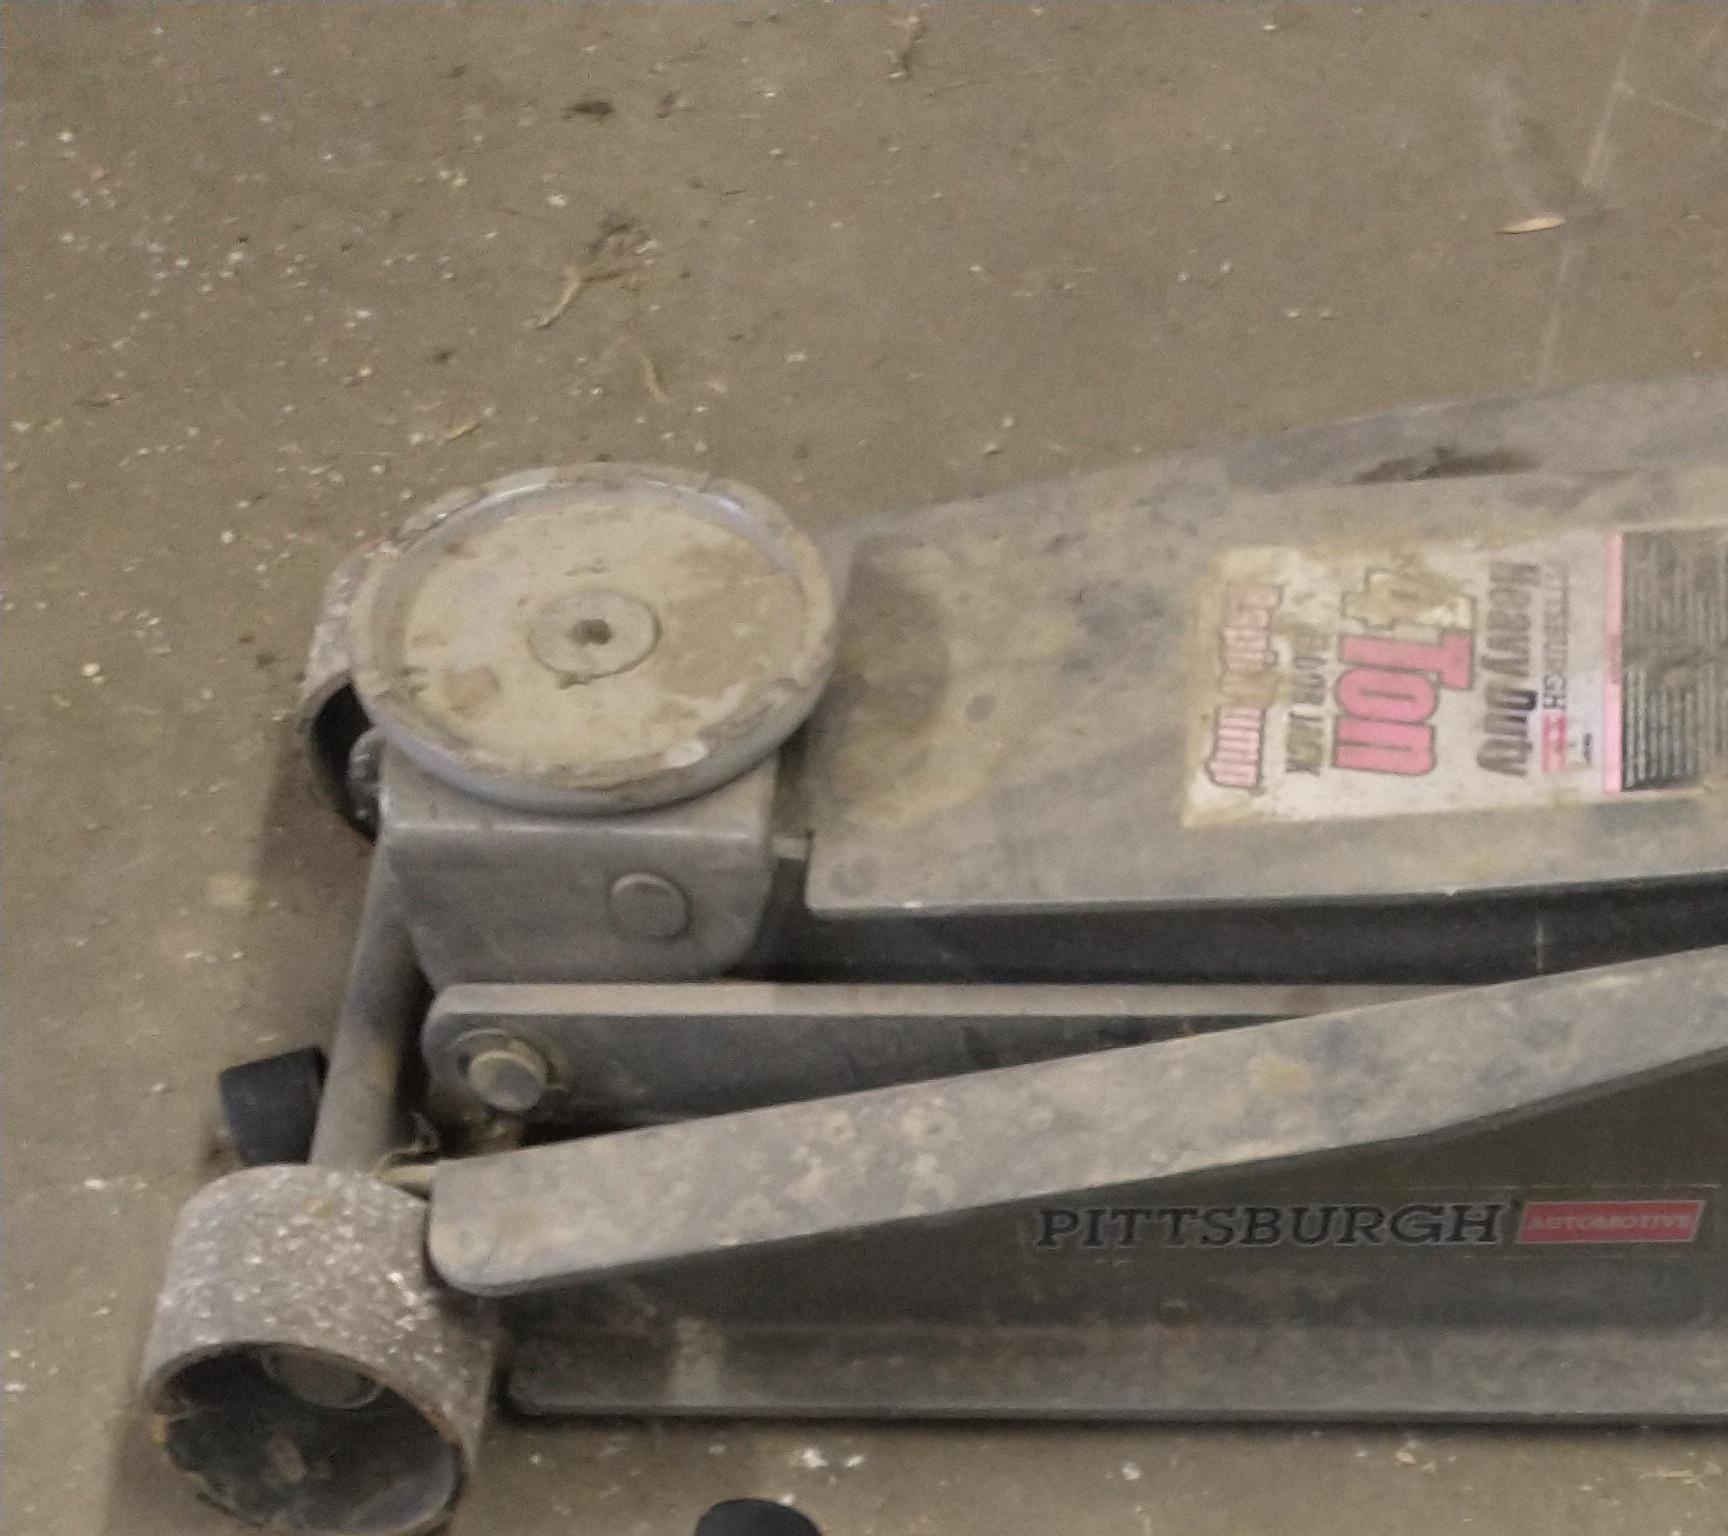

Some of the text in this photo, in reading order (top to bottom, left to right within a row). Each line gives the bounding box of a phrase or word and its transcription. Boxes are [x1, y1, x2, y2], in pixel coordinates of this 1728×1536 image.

[1332, 628, 1475, 777] Ton
[1476, 560, 1541, 778] Heavy Duty
[1036, 1202, 1502, 1247] PITTSBURGH
